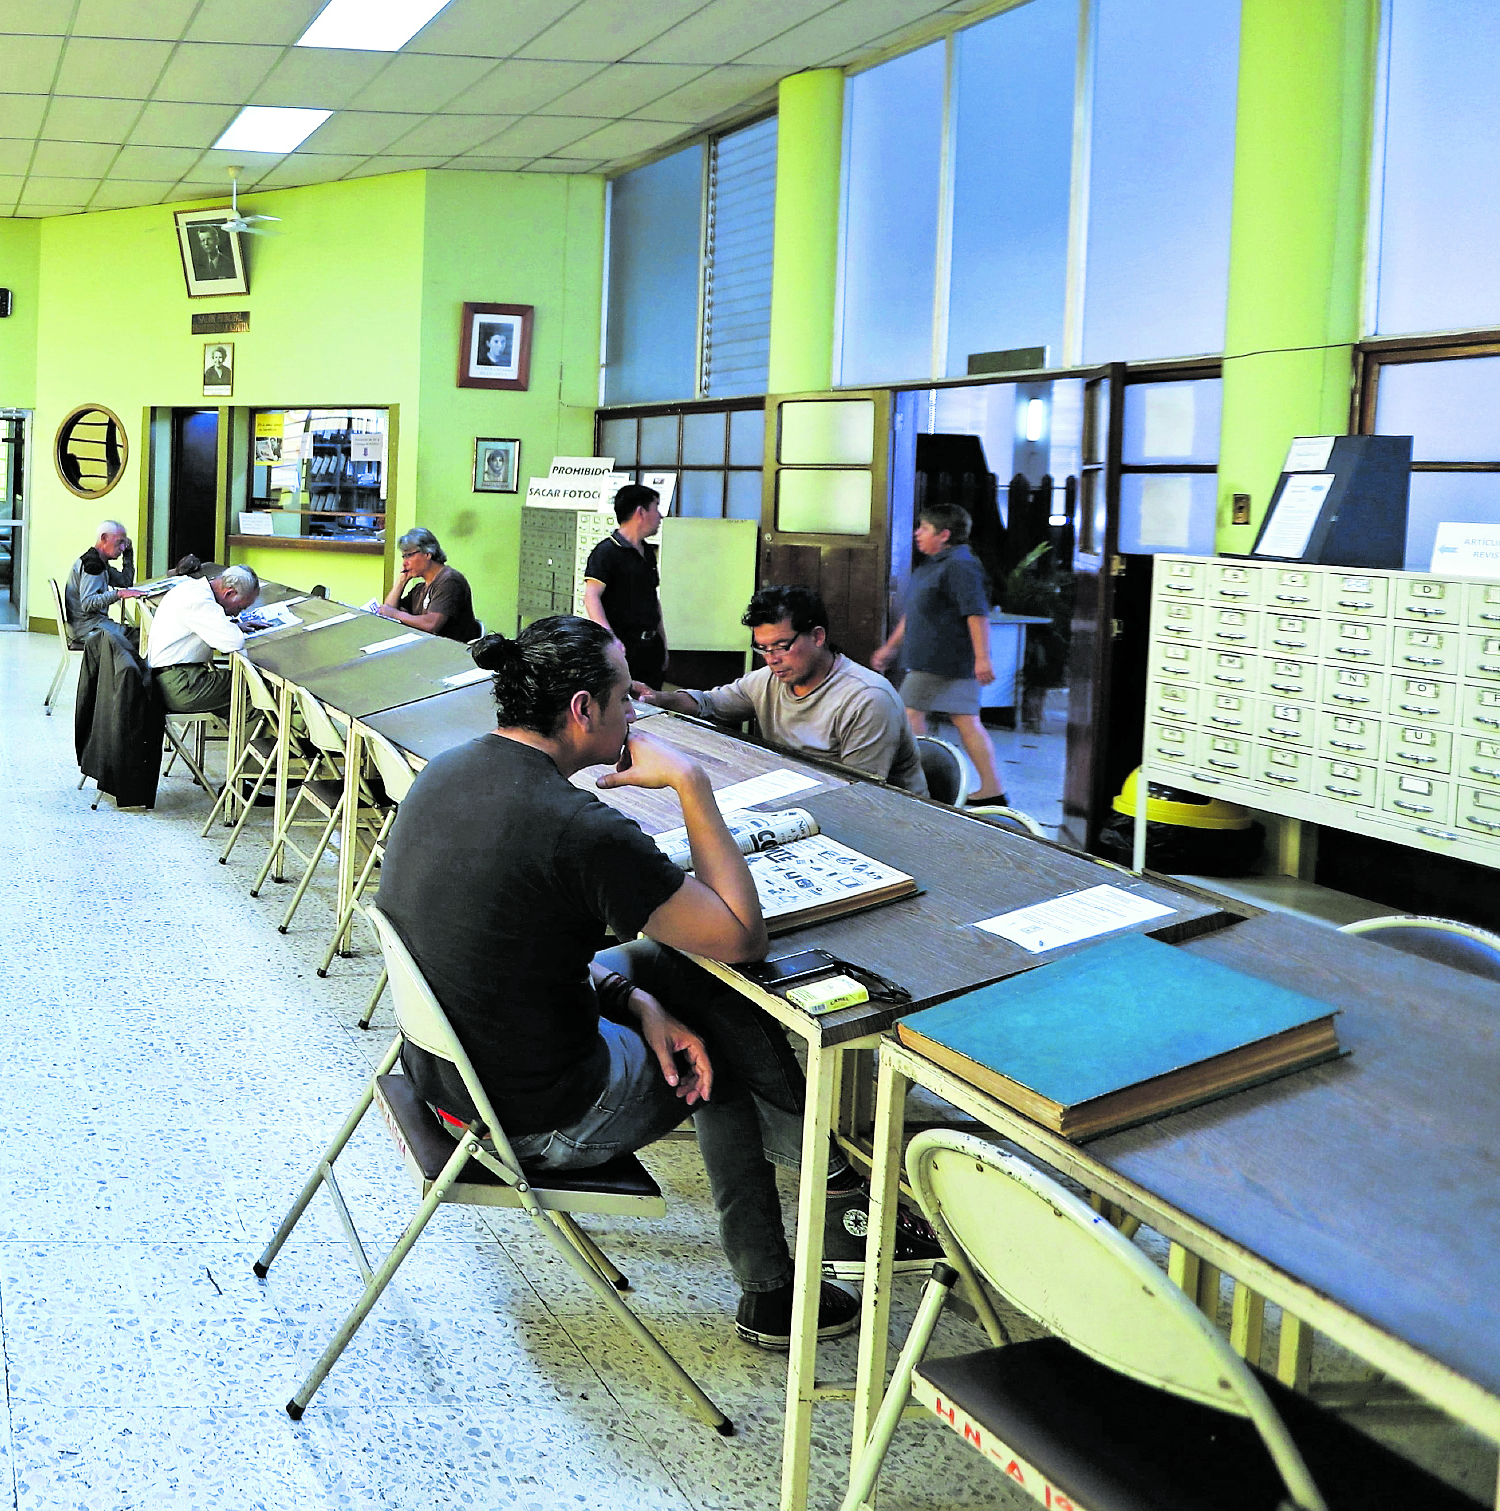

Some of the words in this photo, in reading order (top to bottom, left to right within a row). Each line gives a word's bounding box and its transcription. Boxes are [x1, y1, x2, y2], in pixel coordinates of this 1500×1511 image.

[552, 466, 611, 476] PROHIBIDO
[529, 487, 560, 498] SACAR
[1418, 684, 1426, 692] O
[1283, 709, 1289, 717] S
